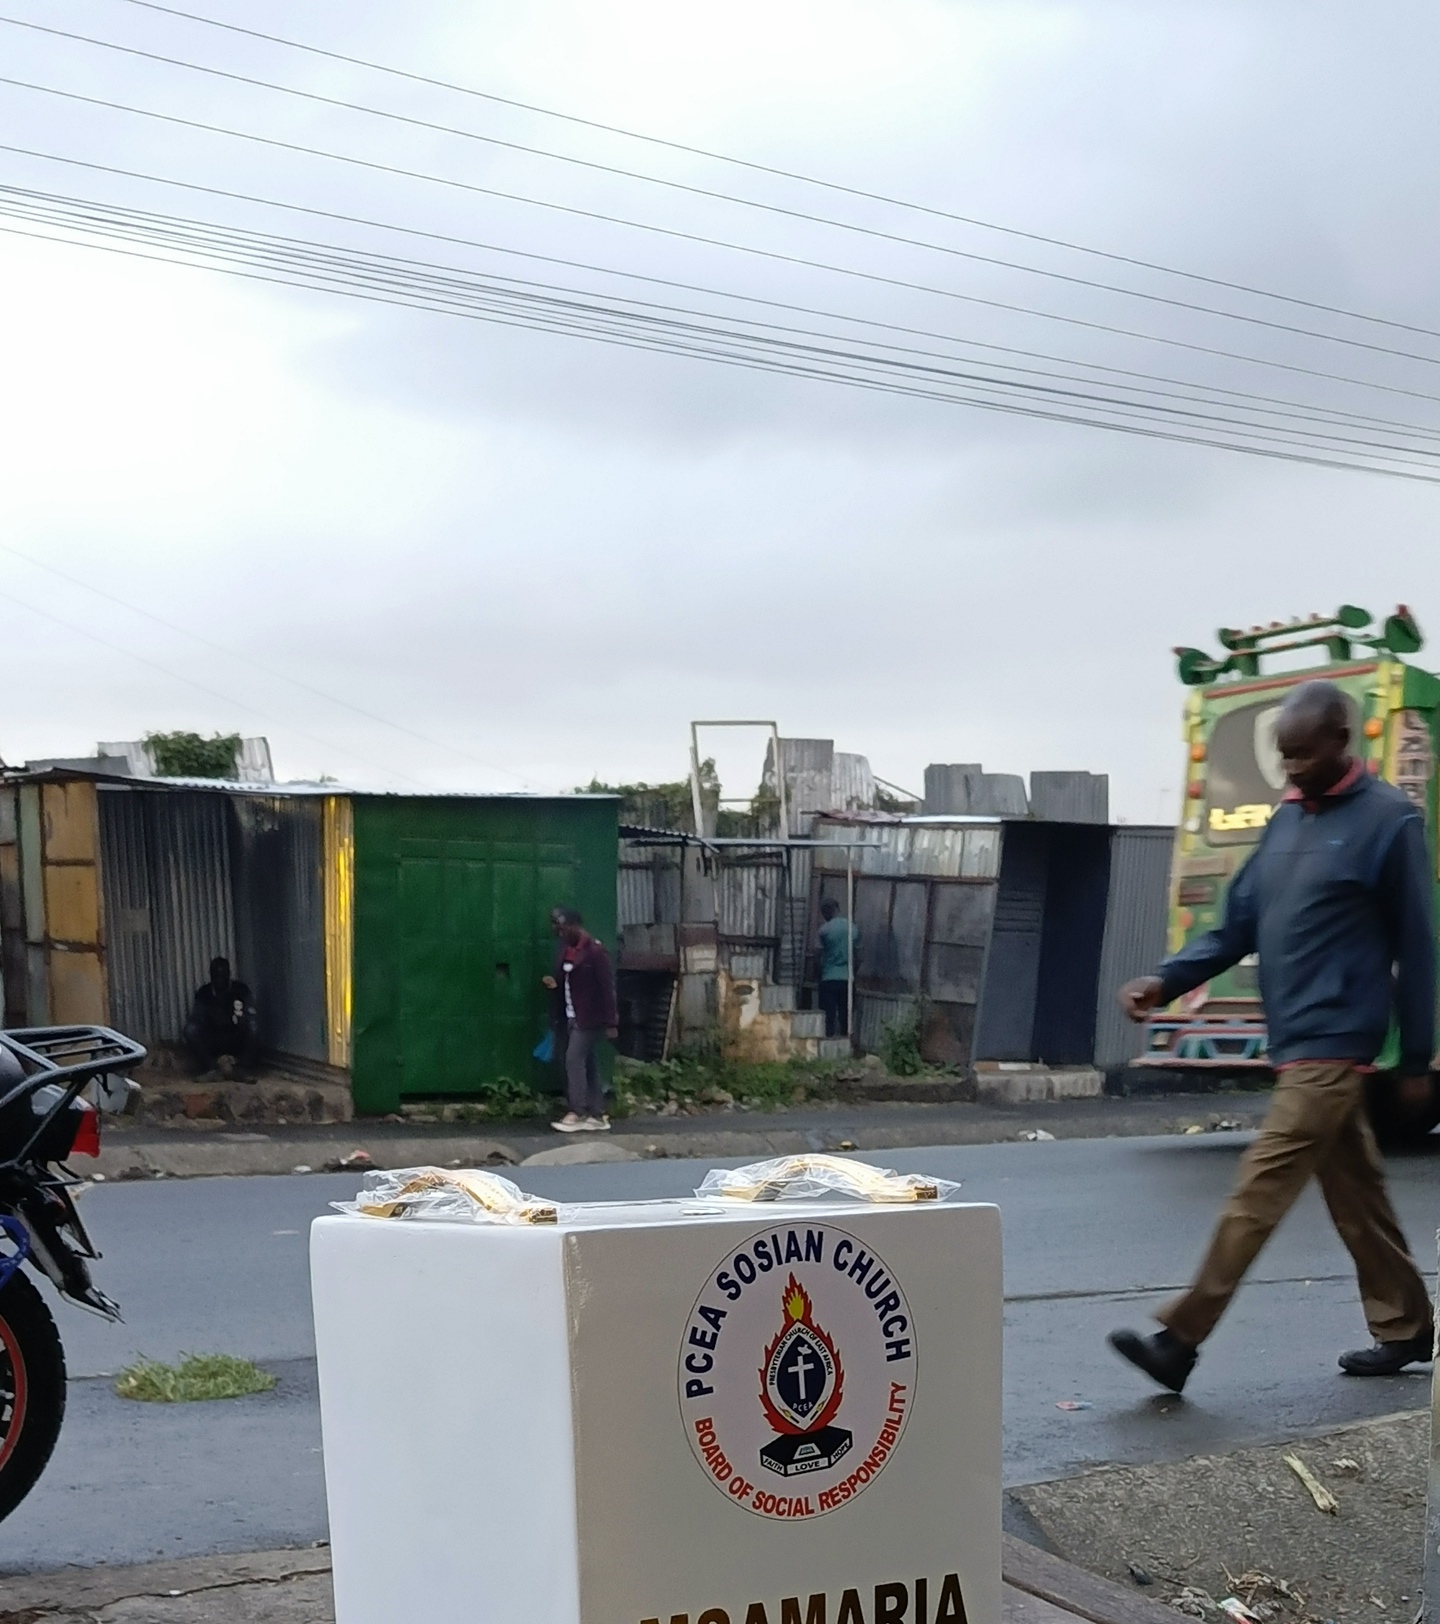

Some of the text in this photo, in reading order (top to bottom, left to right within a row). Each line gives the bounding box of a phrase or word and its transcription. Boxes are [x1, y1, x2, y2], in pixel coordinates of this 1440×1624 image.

[685, 1230, 911, 1399] PCEA SOSIAN CHURCH
[792, 1401, 814, 1412] PCEA
[695, 1381, 907, 1517] BOARD OF SOCIAL RESPONSIBILITY
[832, 1442, 850, 1460] HOPE
[763, 1458, 784, 1471] FAITH
[795, 1461, 820, 1472] LOVE
